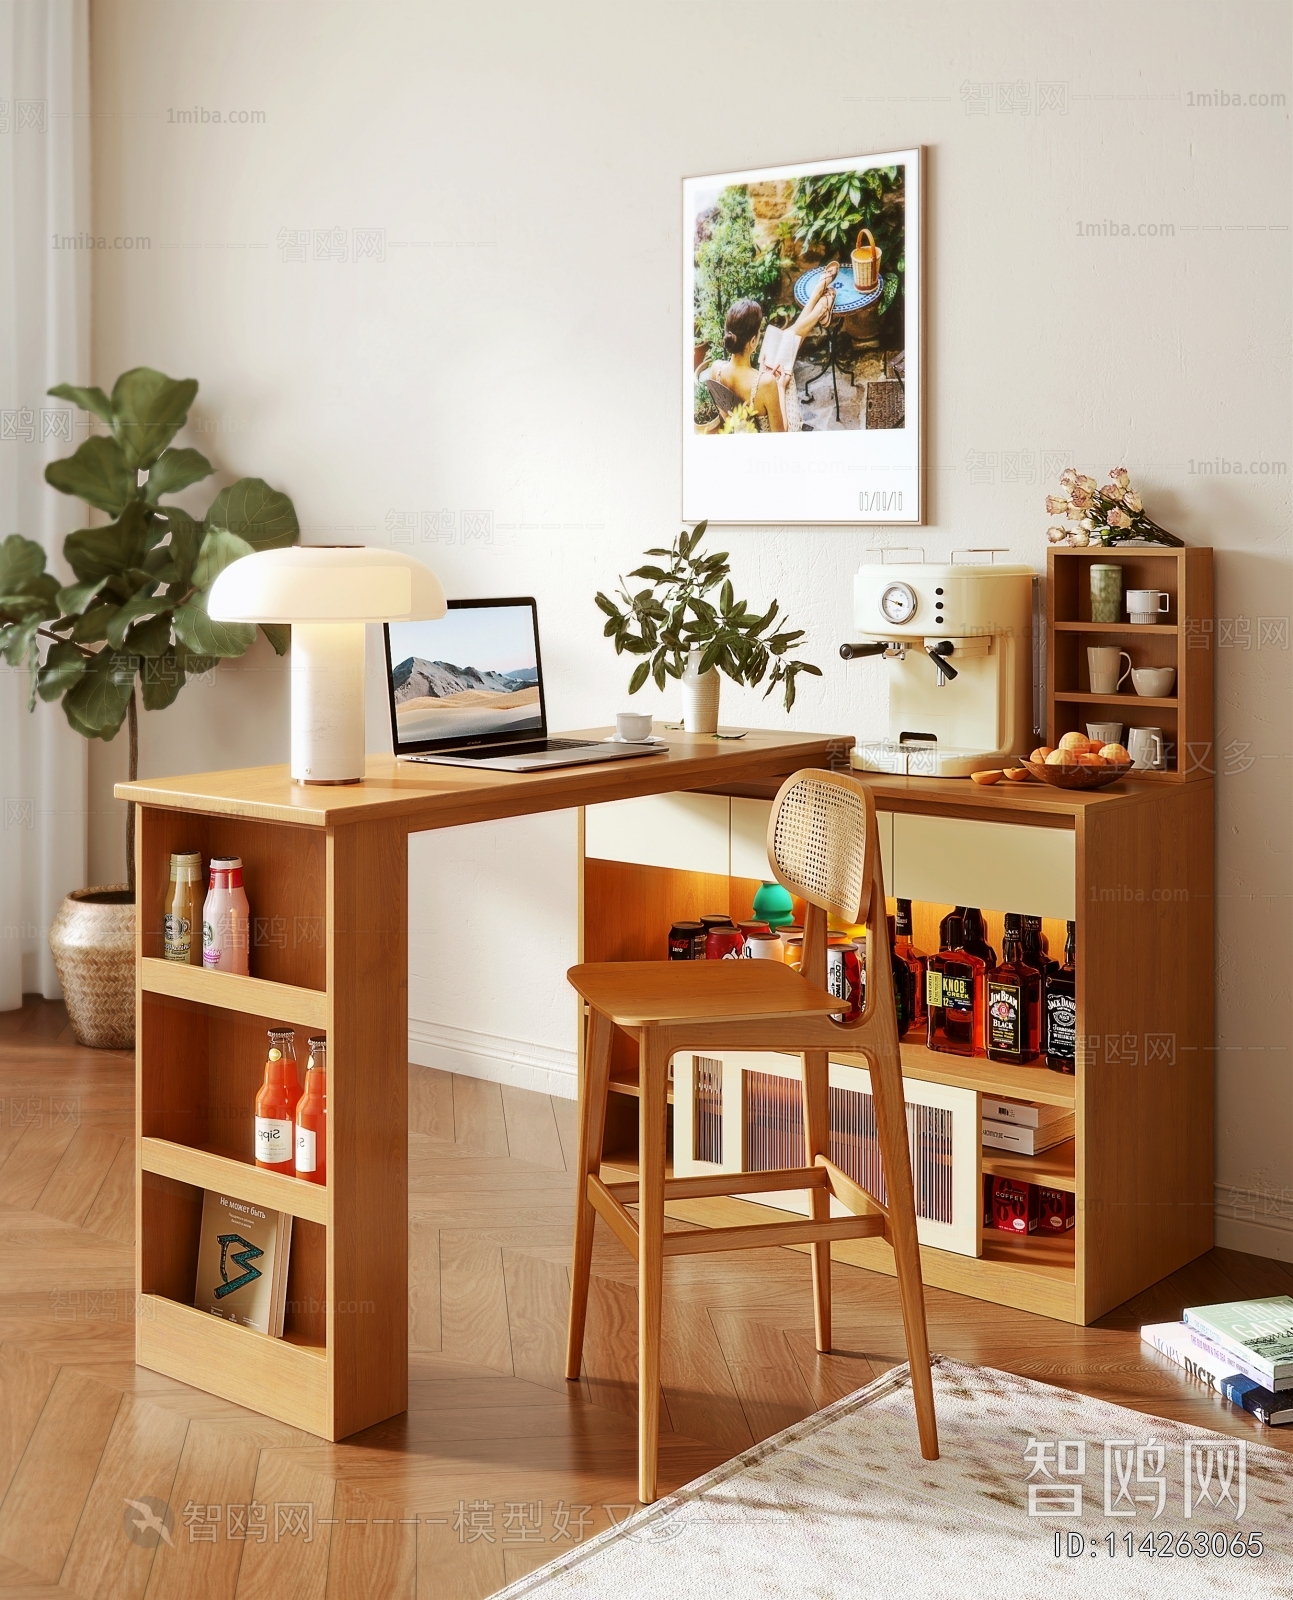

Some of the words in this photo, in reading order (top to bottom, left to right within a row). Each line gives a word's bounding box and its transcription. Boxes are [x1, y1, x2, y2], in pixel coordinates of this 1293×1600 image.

[943, 978, 965, 993] KNOB
[1001, 990, 1018, 1010] BEAM
[993, 1019, 1013, 1029] BLACK
[996, 1191, 1025, 1201] COFFEE
[220, 1197, 229, 1207] Не
[229, 1201, 250, 1214] может
[250, 1206, 266, 1219] быть
[1184, 1355, 1217, 1389] DICK
